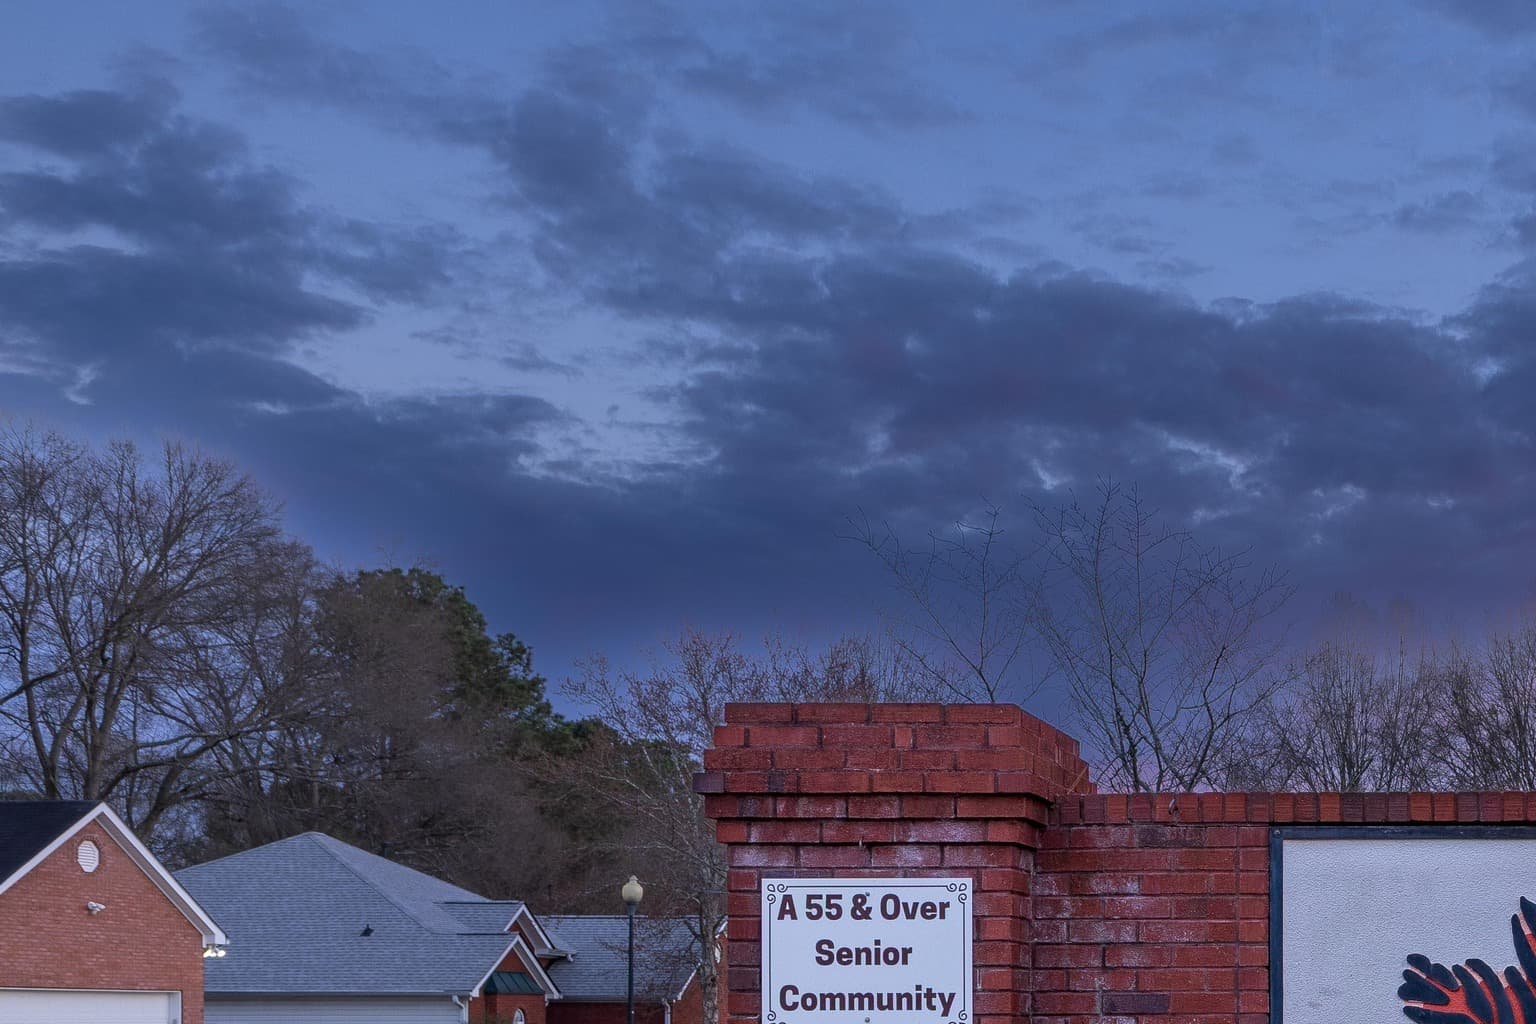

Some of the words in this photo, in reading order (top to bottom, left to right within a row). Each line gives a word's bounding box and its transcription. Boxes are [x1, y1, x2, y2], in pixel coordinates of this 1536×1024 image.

[777, 894, 798, 921] A
[805, 894, 843, 921] 55
[850, 893, 873, 921] &
[880, 893, 950, 921] Over
[815, 939, 913, 966] Senior
[779, 984, 956, 1018] Community
